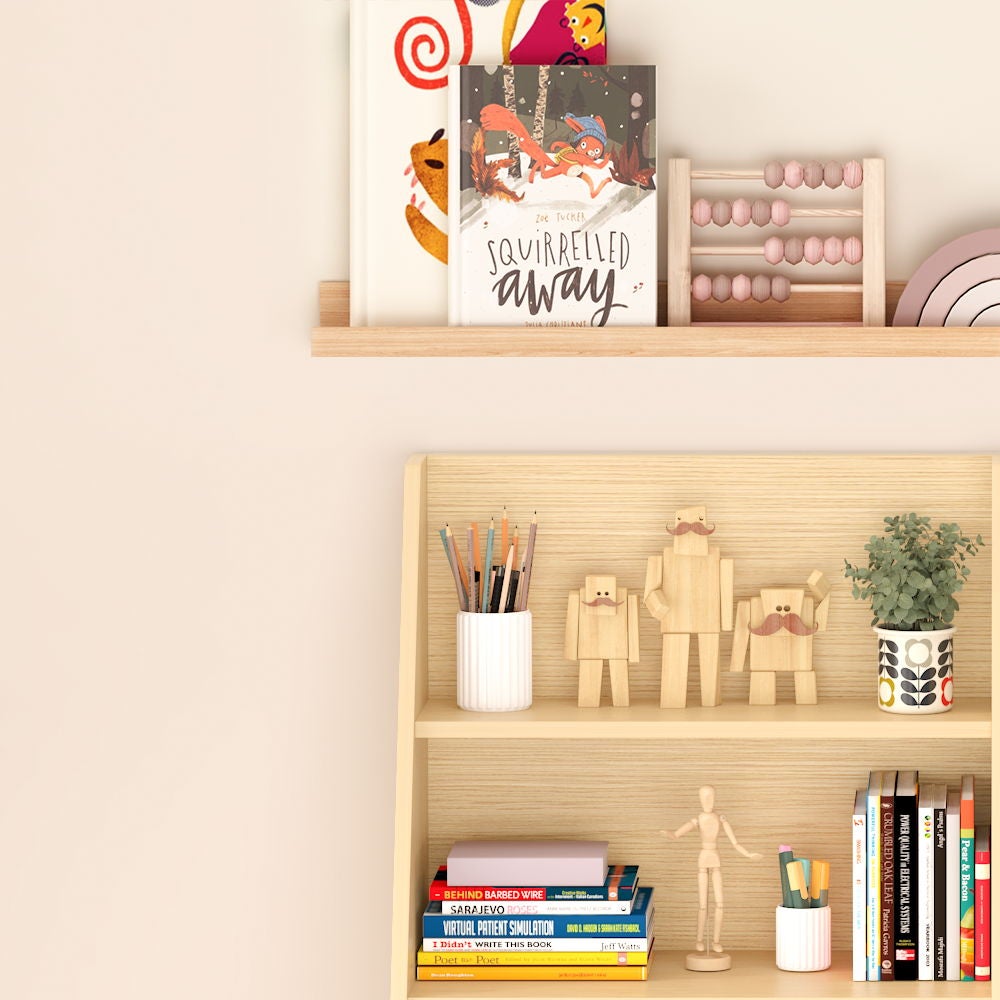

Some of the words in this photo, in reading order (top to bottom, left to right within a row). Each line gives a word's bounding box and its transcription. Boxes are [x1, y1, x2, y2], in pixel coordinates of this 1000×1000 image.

[487, 229, 630, 276] SQUIRRELLED
[492, 267, 628, 327] away
[899, 814, 910, 835] POWER
[883, 812, 893, 860] CRUMBLED
[899, 835, 910, 862] QUALITY
[961, 839, 970, 857] Pear
[883, 861, 893, 881] OAK
[443, 890, 483, 900] BEHIND
[484, 890, 520, 900] BARBED
[521, 890, 544, 900] WIRE
[884, 883, 894, 904] LEAF
[899, 868, 910, 905] ELECTRICAL
[961, 874, 970, 902] Bacon
[450, 905, 505, 915] SARAJEVO
[882, 908, 891, 932] Patricia
[899, 905, 910, 934] SYSTEMS
[443, 919, 476, 936] VIRTUAL
[477, 919, 508, 936] PATIENT
[509, 919, 554, 936] SIMULATION
[440, 940, 472, 948] Didn't
[600, 941, 616, 951] Jeff
[617, 941, 641, 950] Watts
[434, 955, 458, 964] Poet
[476, 955, 500, 964] Poet
